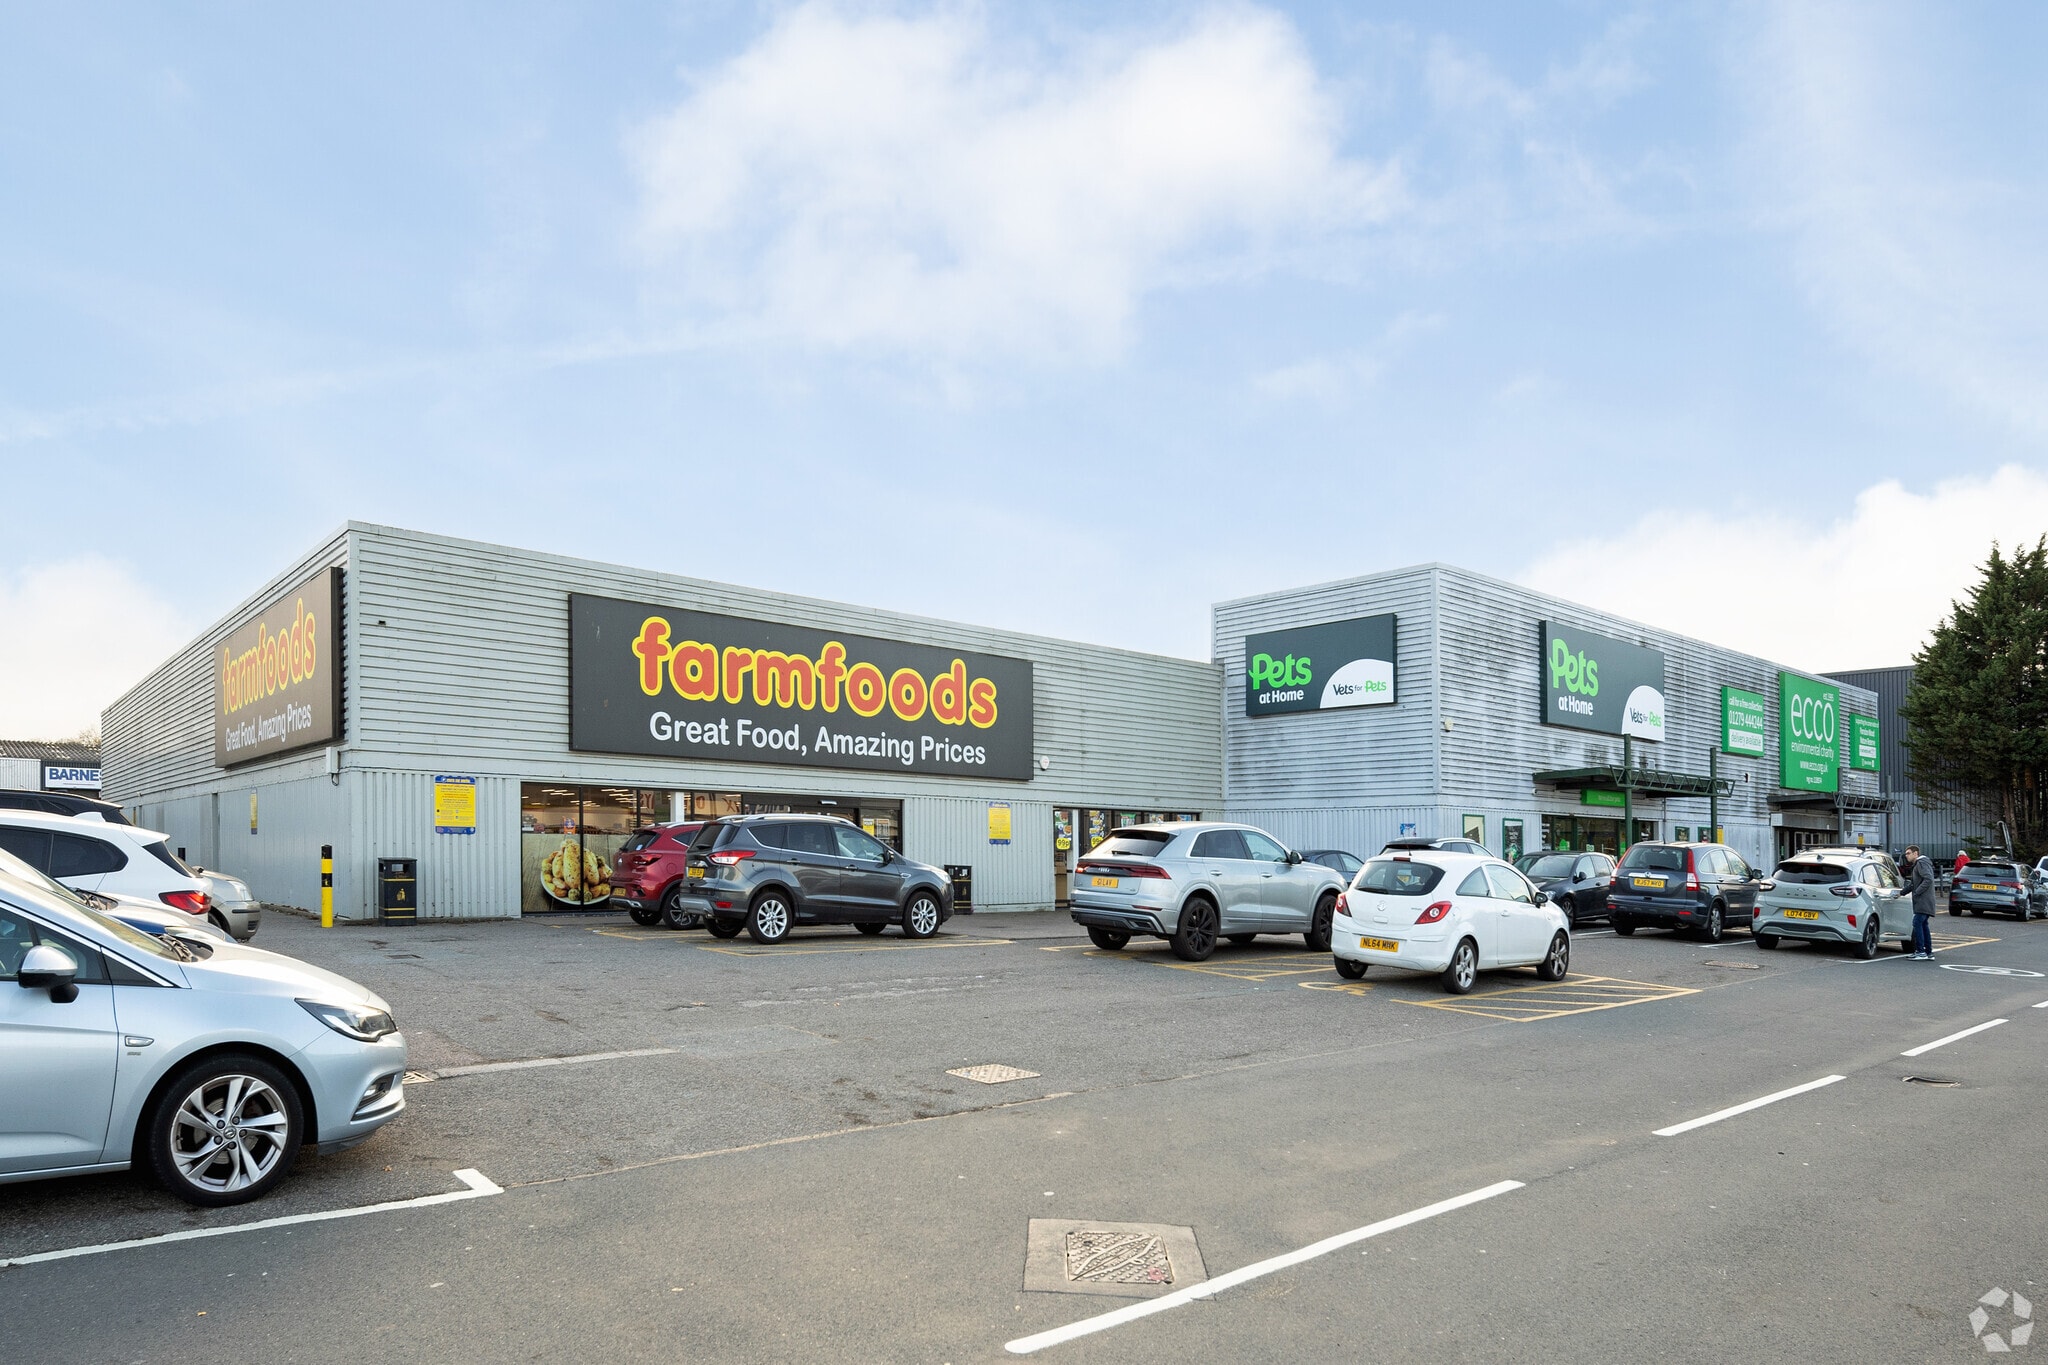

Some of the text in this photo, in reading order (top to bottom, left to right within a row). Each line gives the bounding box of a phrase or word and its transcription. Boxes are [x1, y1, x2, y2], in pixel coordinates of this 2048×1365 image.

[223, 598, 316, 715] farmfoods
[632, 616, 998, 729] farmfoods
[1248, 653, 1312, 690] Pets
[1549, 639, 1598, 697] Pets
[1259, 689, 1304, 704] at Home
[1333, 680, 1387, 696] Vets for Pets
[1558, 695, 1593, 716] at Home
[226, 702, 312, 751] Great Food, Amazing Prices
[1629, 707, 1643, 724] Vets
[1649, 711, 1662, 727] Pets
[1729, 710, 1744, 726] 01279
[1791, 694, 1834, 743] ecco
[650, 711, 986, 765] Great Food, Amazing Prices
[49, 768, 101, 781] BARNE
[1058, 839, 1070, 848] 99p
[1362, 938, 1381, 948] NL64
